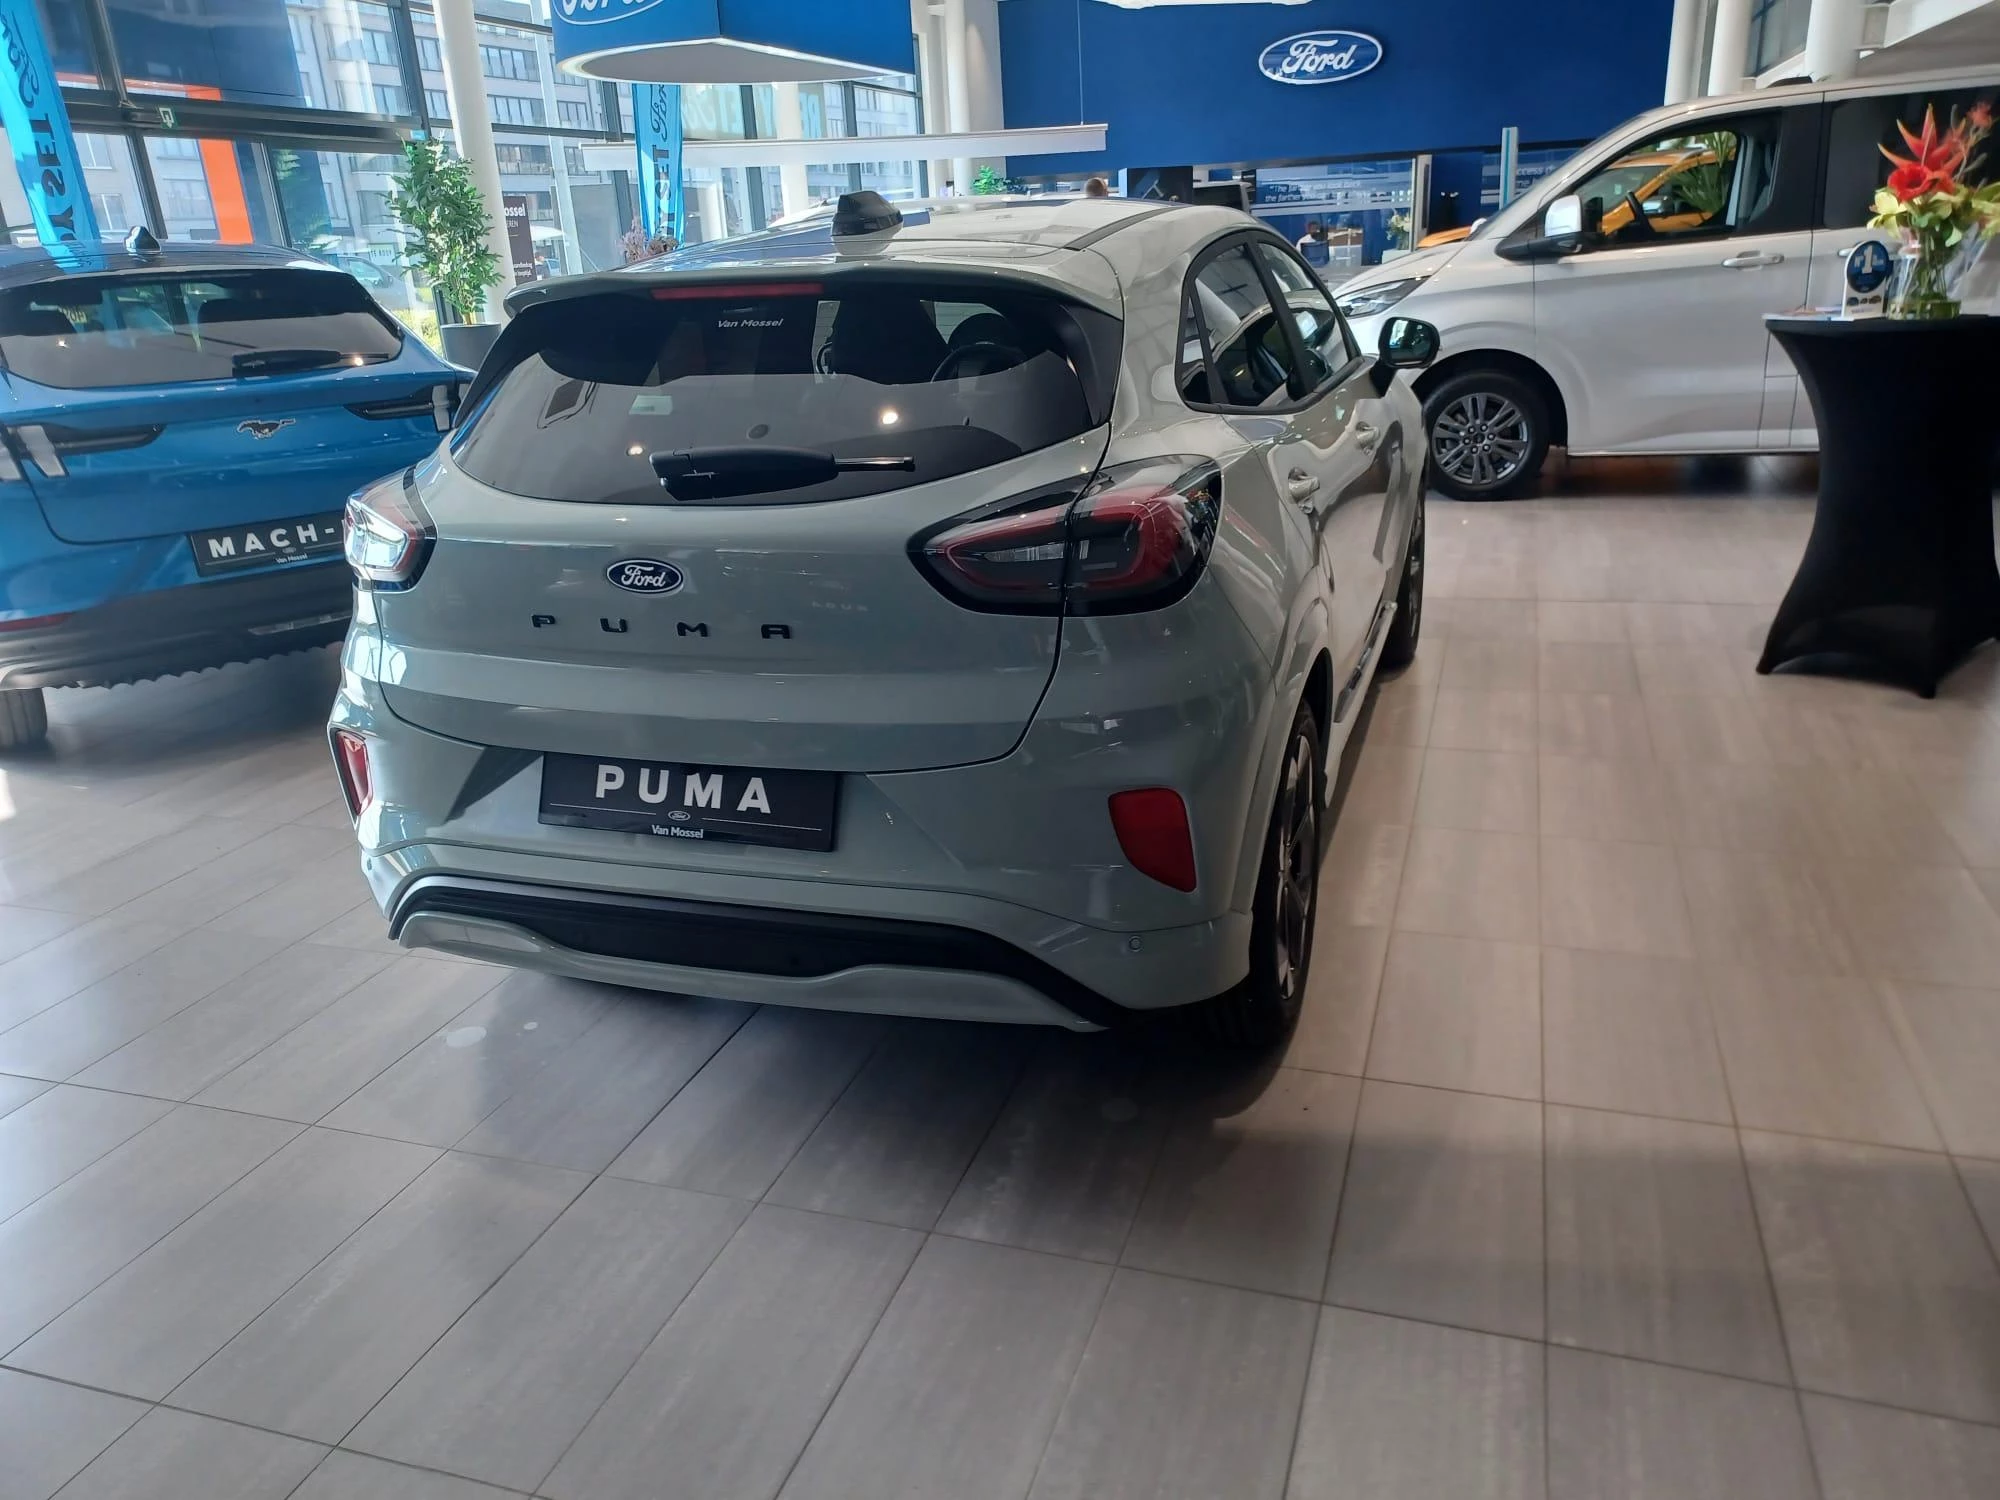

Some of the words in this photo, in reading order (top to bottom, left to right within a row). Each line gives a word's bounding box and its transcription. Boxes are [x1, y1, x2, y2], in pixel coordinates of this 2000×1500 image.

[1282, 39, 1358, 74] Ford
[650, 84, 668, 142] For
[503, 203, 526, 217] ossel
[718, 319, 738, 328] Van
[741, 318, 784, 327] Mossel
[208, 519, 345, 558] MACH-
[621, 564, 666, 588] Ford
[531, 614, 791, 639] PUMA
[595, 764, 771, 814] PUMA
[651, 824, 669, 836] Van
[671, 825, 703, 839] Mossel
